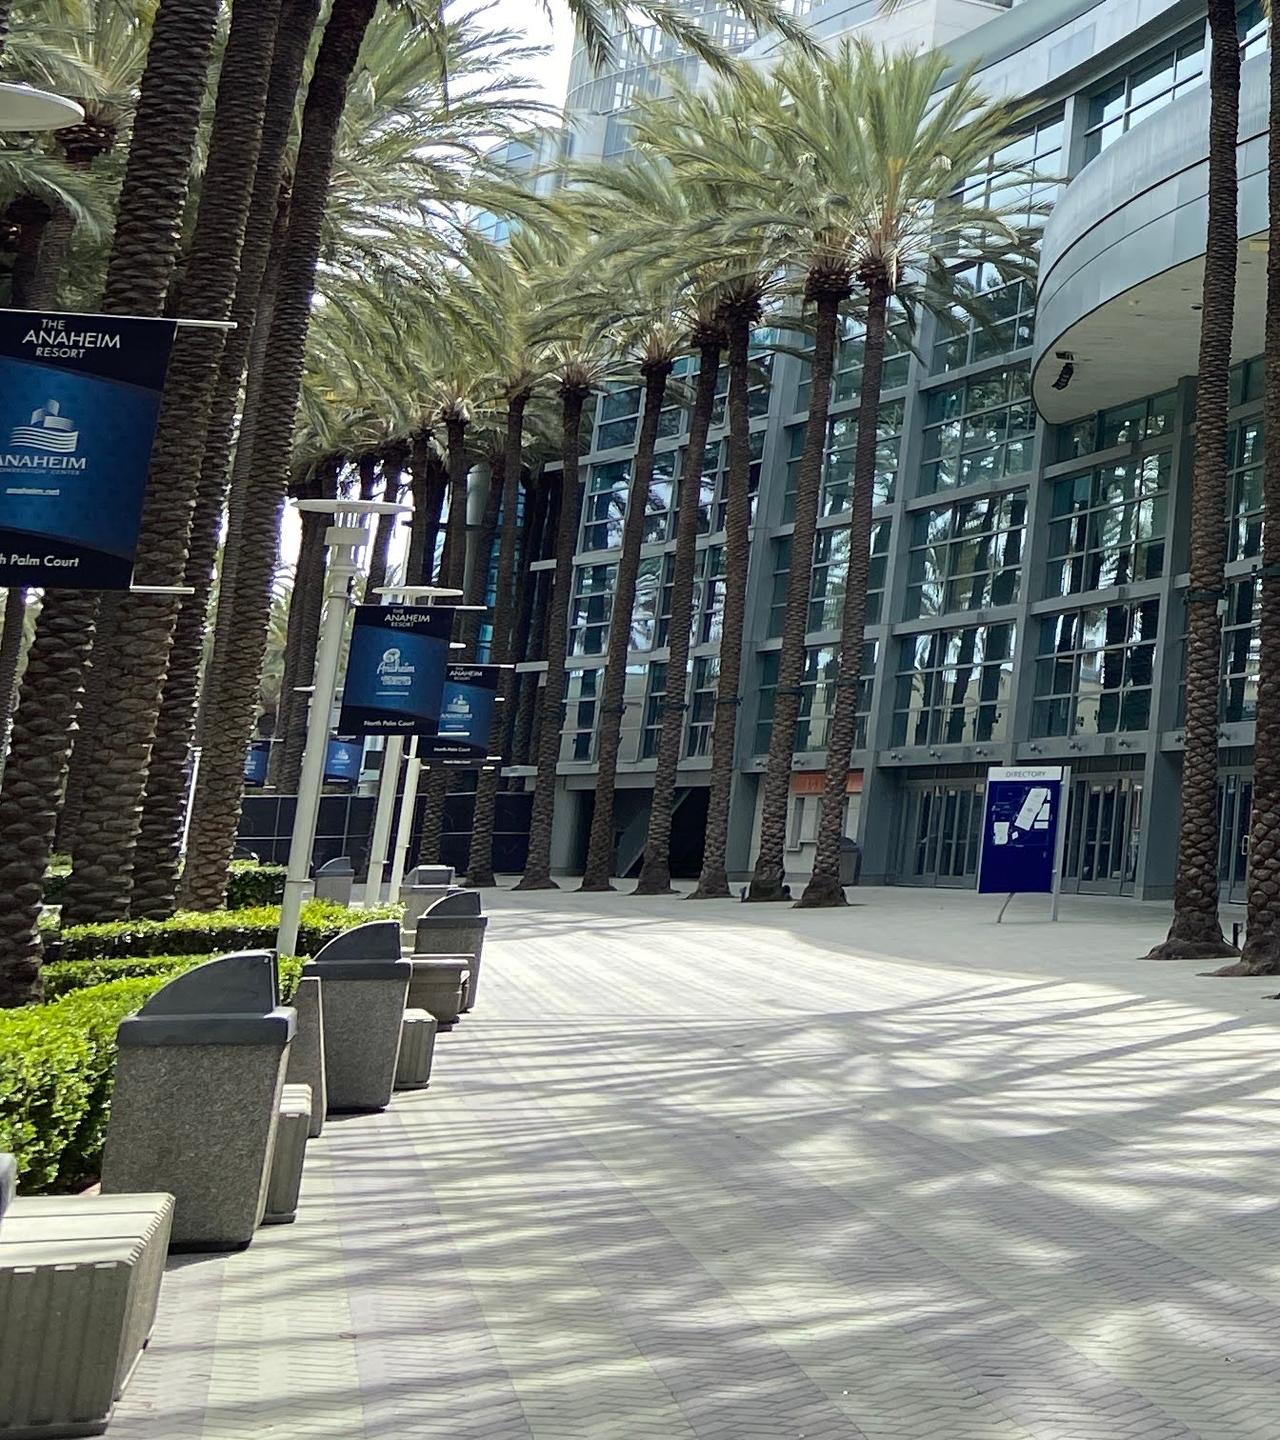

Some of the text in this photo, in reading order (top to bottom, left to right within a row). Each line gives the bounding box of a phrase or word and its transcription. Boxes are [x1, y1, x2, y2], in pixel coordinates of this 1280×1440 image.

[41, 319, 66, 330] THE
[22, 330, 120, 348] ANAHEIM
[36, 347, 86, 358] RESORT
[10, 554, 40, 566] Palm
[44, 555, 79, 567] Court
[384, 614, 430, 623] ANAHEIM
